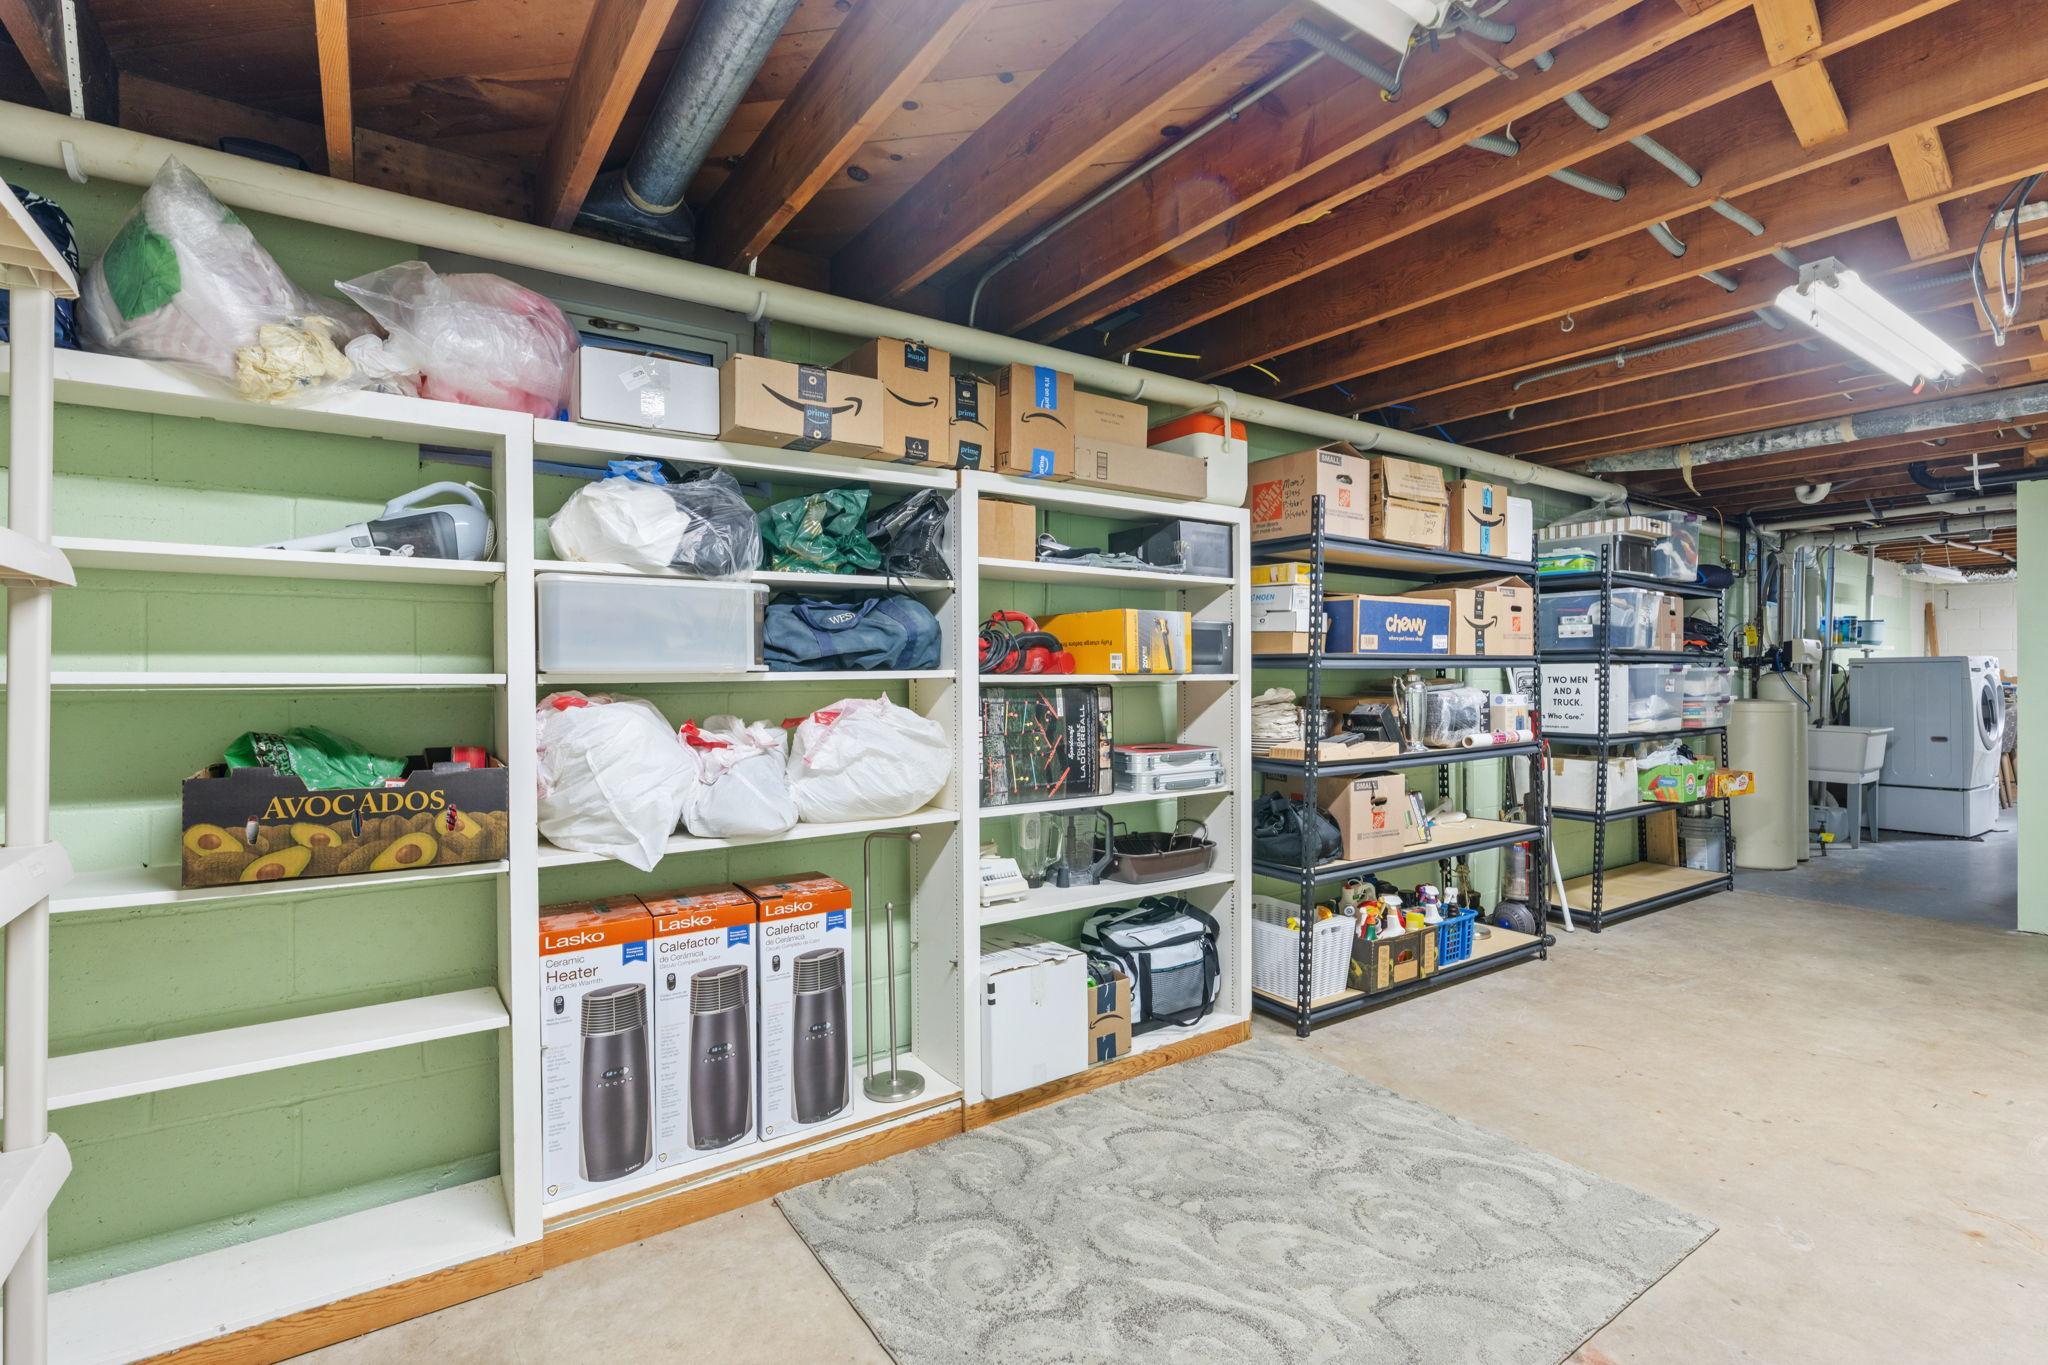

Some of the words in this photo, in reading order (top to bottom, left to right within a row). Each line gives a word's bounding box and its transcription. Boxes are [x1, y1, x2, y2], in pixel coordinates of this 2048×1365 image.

[807, 409, 829, 419] prime
[958, 409, 976, 418] prime
[960, 446, 979, 456] prime
[1321, 454, 1341, 465] SMALL
[1255, 593, 1275, 601] MOEN
[1385, 613, 1427, 636] chewy
[1547, 676, 1567, 684] TWO
[1570, 676, 1588, 684] MEN
[1553, 687, 1571, 695] AND
[1574, 687, 1581, 695] A
[1553, 698, 1583, 707] TRUCK.
[260, 789, 446, 820] AVOCADOS
[765, 901, 813, 917] Lasko
[659, 915, 712, 932] Lasko
[765, 921, 820, 937] Calefactor
[544, 931, 605, 950] Lasko
[659, 935, 720, 953] Calefactor
[545, 956, 585, 969] Ceramic
[546, 966, 599, 984] Heater
